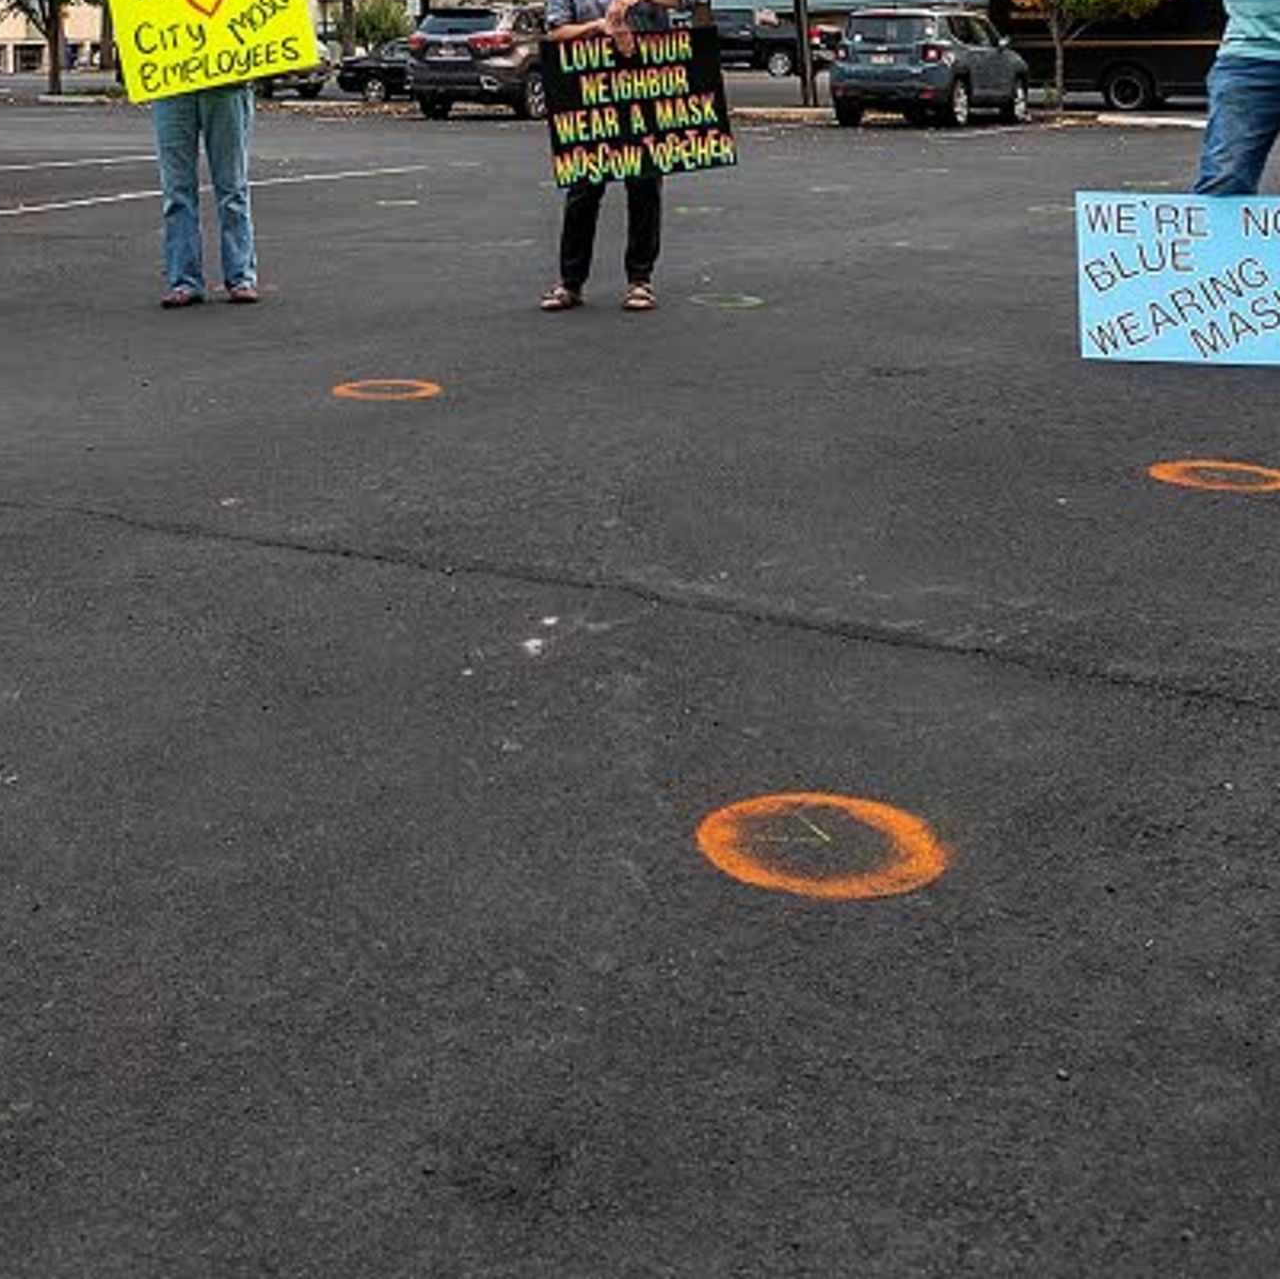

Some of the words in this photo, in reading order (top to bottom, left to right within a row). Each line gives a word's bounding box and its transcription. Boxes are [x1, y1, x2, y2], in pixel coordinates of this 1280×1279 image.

[558, 37, 616, 72] LOVE
[637, 30, 693, 64] YOUR
[580, 66, 690, 106] NEIGHBOR
[554, 106, 620, 144] WEAR
[630, 102, 647, 134] A
[655, 92, 718, 130] MASK
[554, 142, 644, 186] MOSCOW
[642, 130, 736, 173] TOGETHER
[1085, 200, 1209, 237] WE'RE
[1084, 239, 1195, 292] BLUE
[1087, 257, 1269, 356] WEARING
